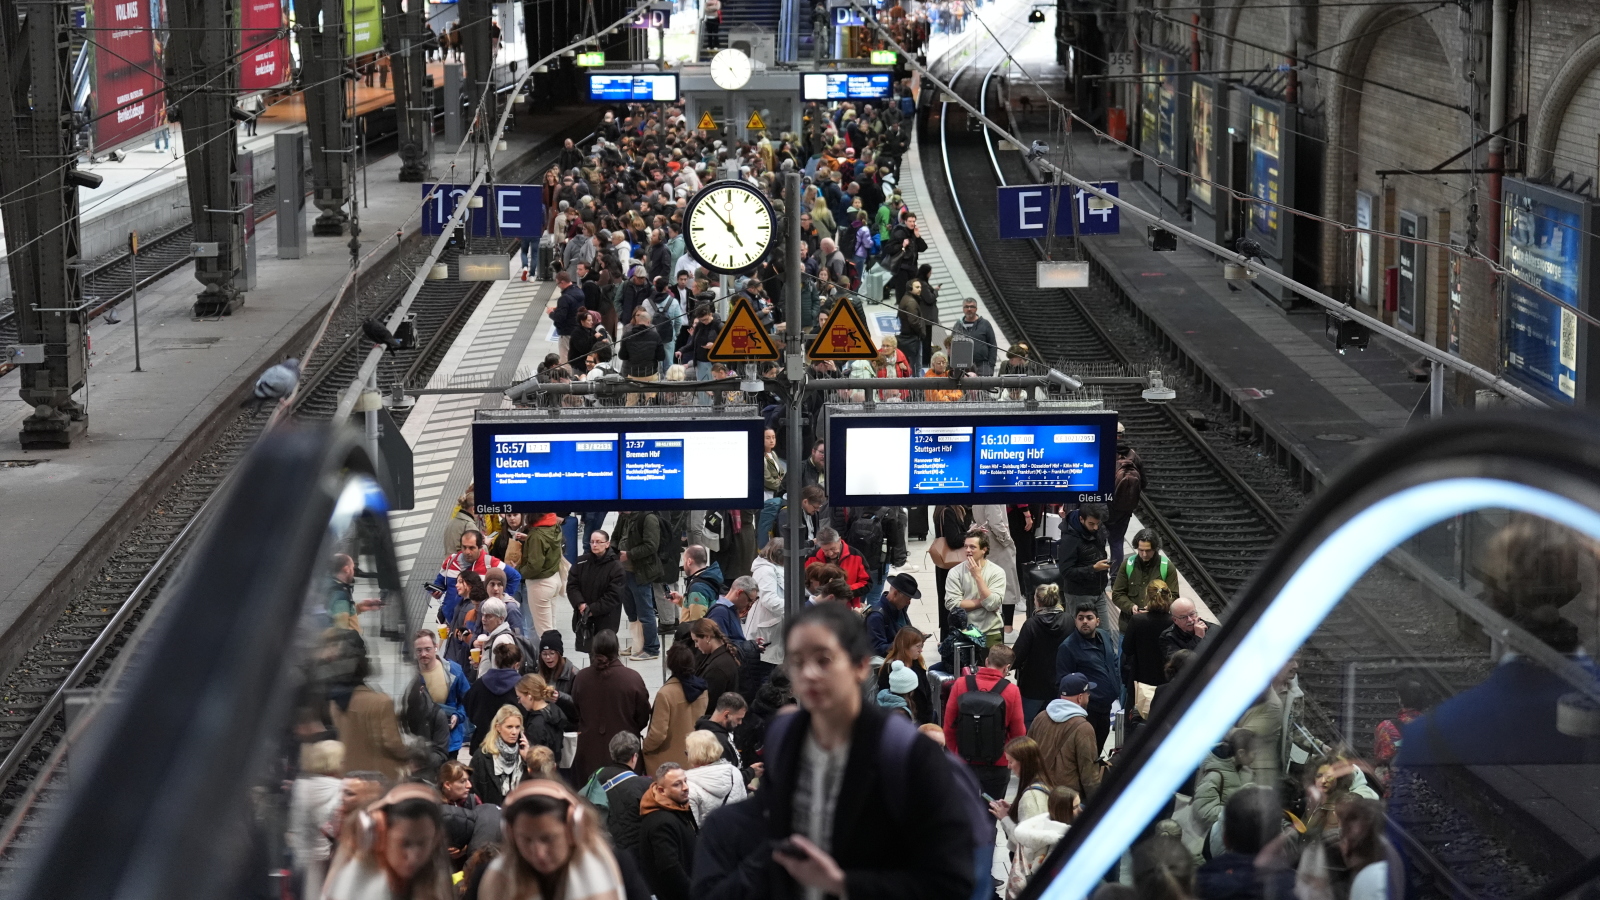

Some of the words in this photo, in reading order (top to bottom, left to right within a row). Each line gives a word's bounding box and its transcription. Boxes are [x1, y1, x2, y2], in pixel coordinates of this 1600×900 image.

[652, 10, 664, 26] D
[838, 8, 850, 24] D
[1110, 54, 1132, 65] 355
[433, 189, 469, 224] 13
[498, 191, 521, 228] E
[1019, 191, 1043, 229] E
[1074, 188, 1112, 223] 14
[981, 434, 1009, 445] 16:10
[496, 443, 525, 454] 16:57
[980, 449, 1024, 461] Nürnberg
[1027, 448, 1044, 459] Hbf
[496, 458, 529, 468] Uelzen
[1078, 494, 1102, 503] Gleis
[1104, 493, 1113, 502] 14
[477, 505, 500, 514] Gleis
[503, 504, 512, 513] 13
